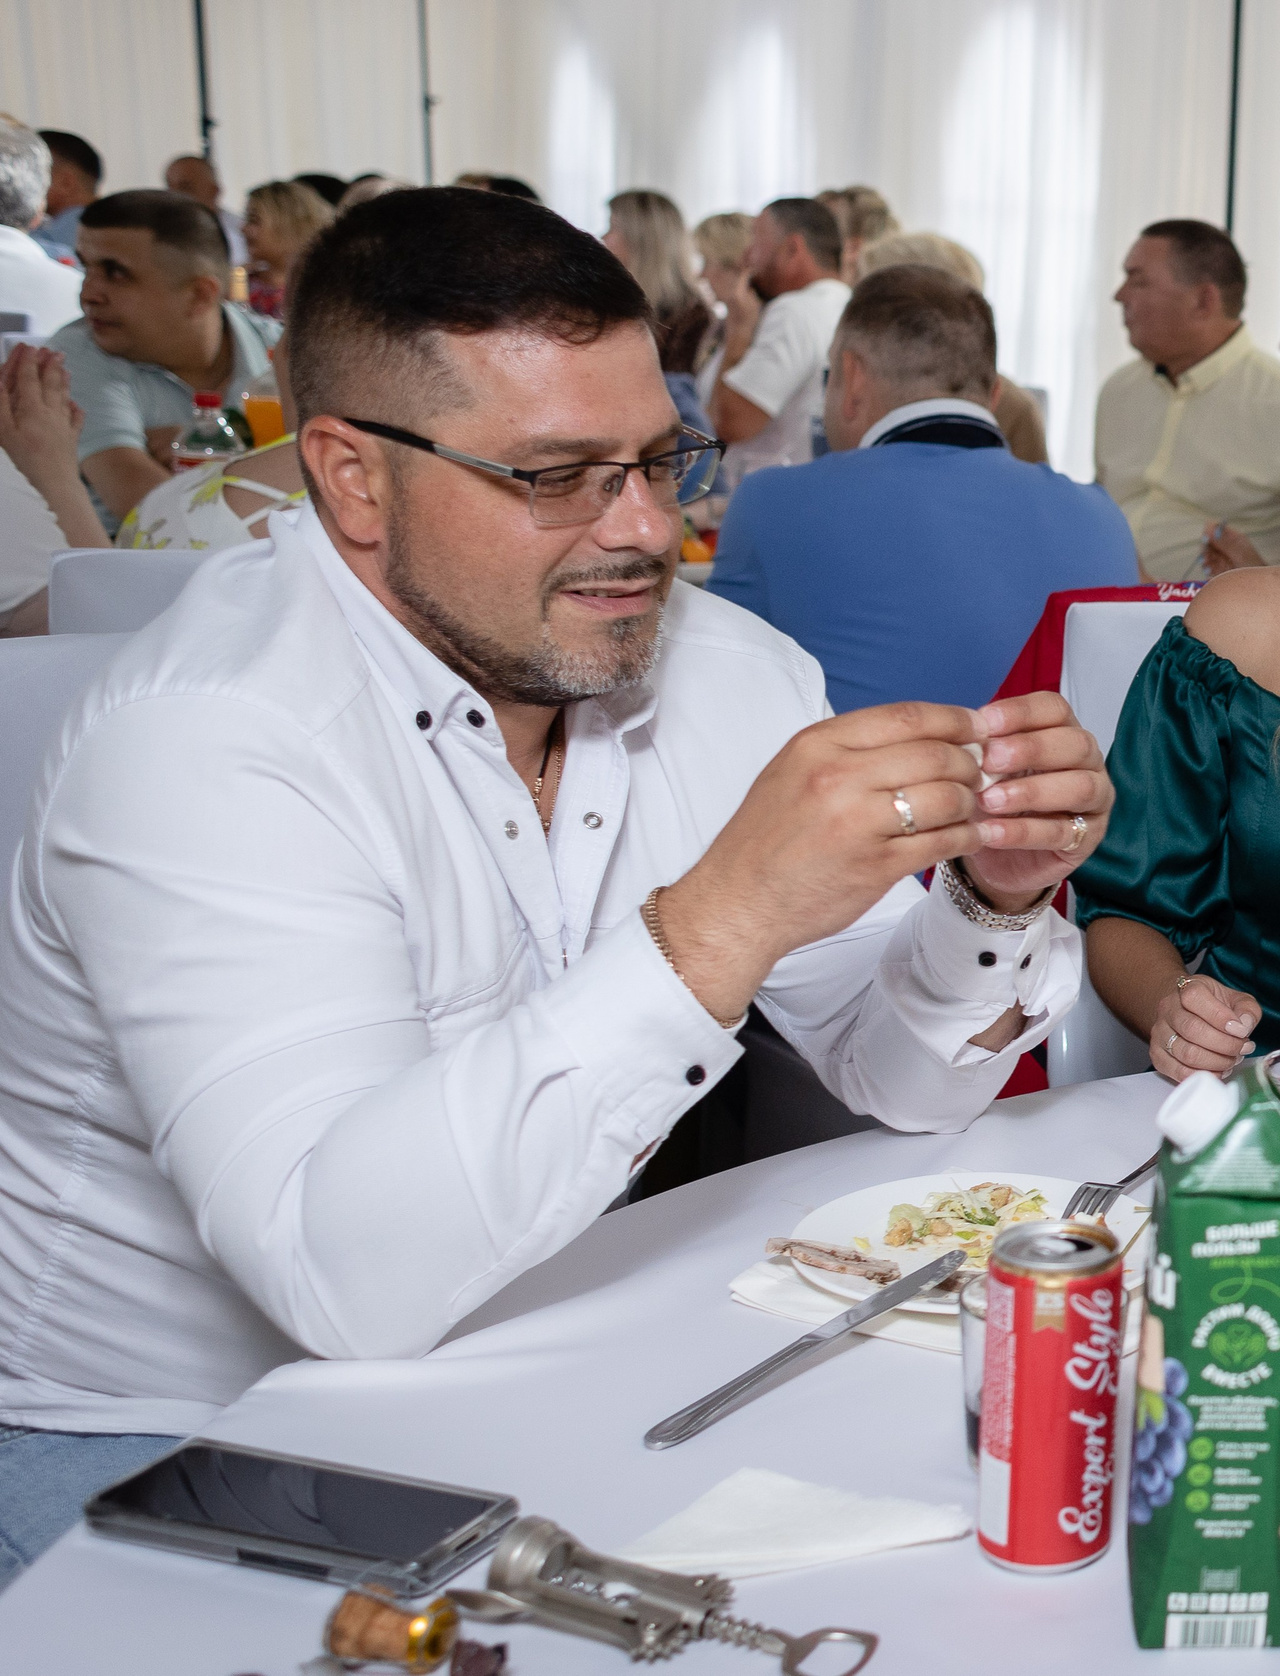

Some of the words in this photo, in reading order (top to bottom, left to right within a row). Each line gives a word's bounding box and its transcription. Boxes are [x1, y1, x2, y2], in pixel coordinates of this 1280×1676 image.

[1206, 1220, 1280, 1242] БОЛЬШЕ
[1191, 1239, 1261, 1258] ПОЛЬЗЫ
[1064, 1288, 1116, 1396] Style
[1201, 1361, 1273, 1389] ВМЕСТЕ
[1057, 1408, 1109, 1543] Export
